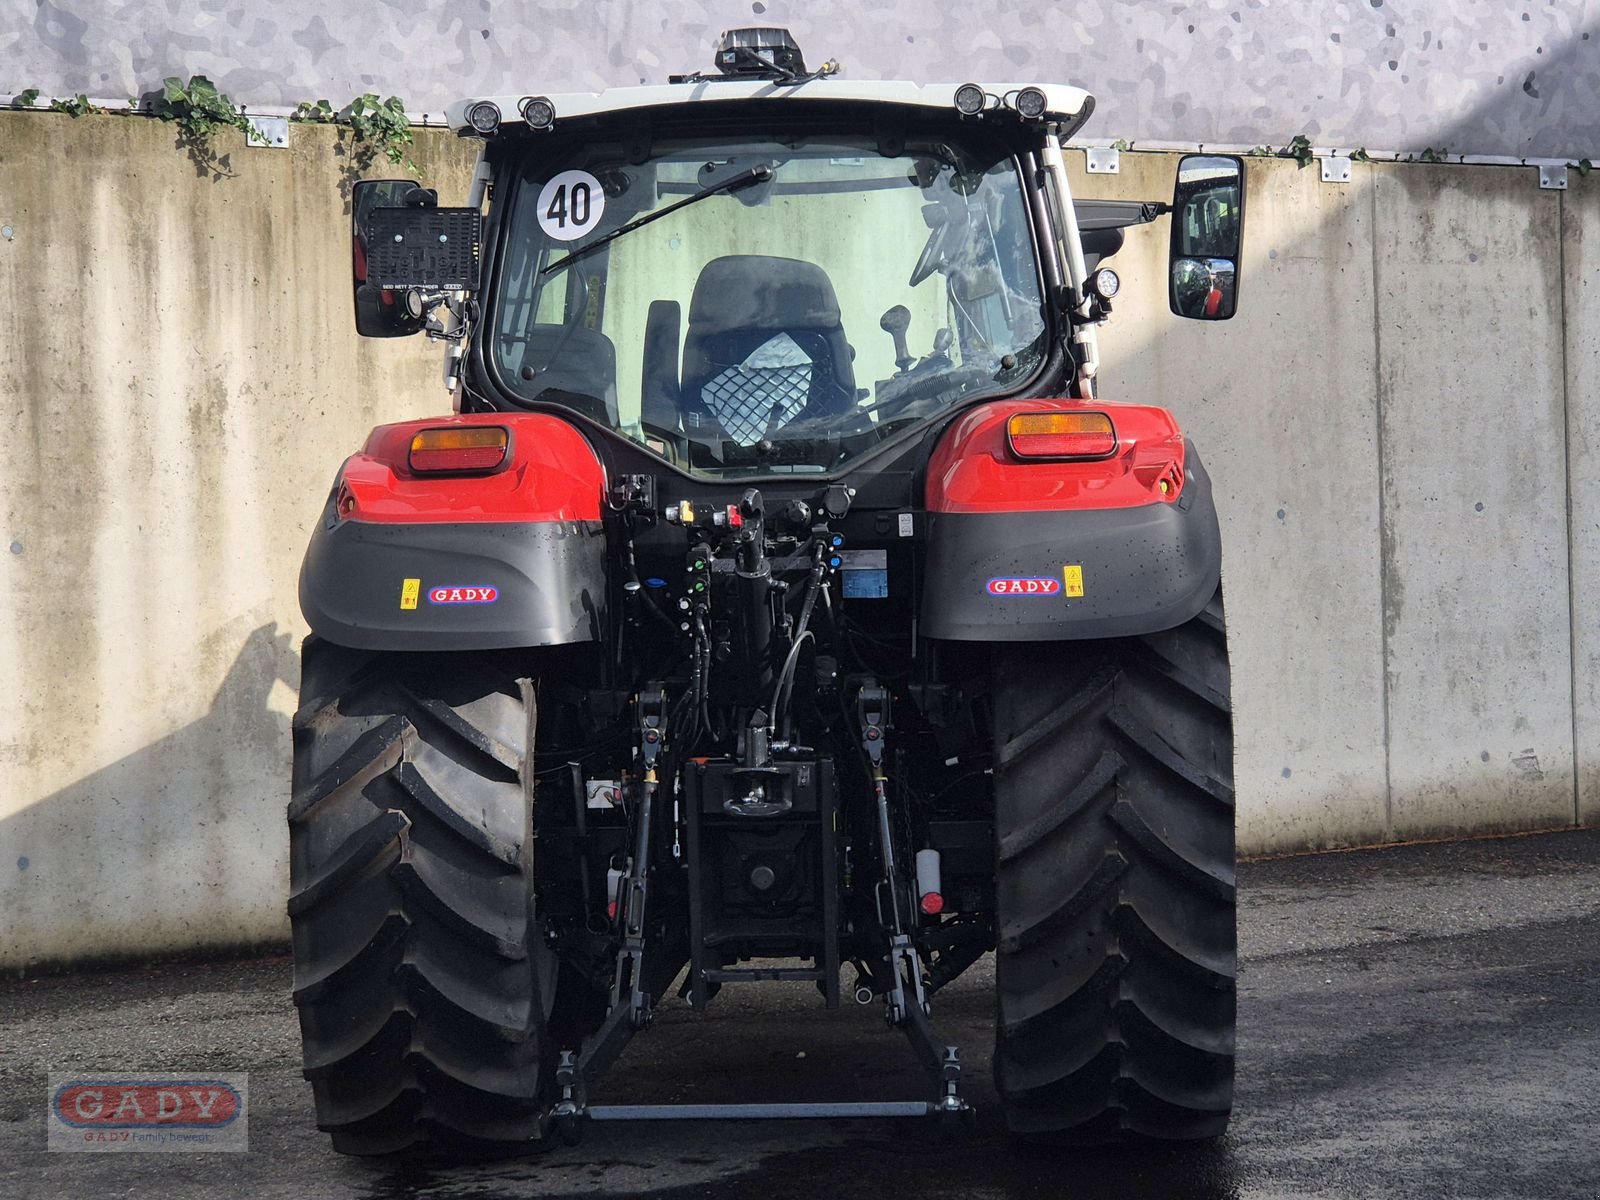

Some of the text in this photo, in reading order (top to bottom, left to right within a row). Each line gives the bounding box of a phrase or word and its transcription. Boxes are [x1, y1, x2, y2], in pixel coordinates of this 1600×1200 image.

[547, 182, 590, 228] 40
[994, 581, 1053, 593] GADY
[435, 589, 491, 601] GADY
